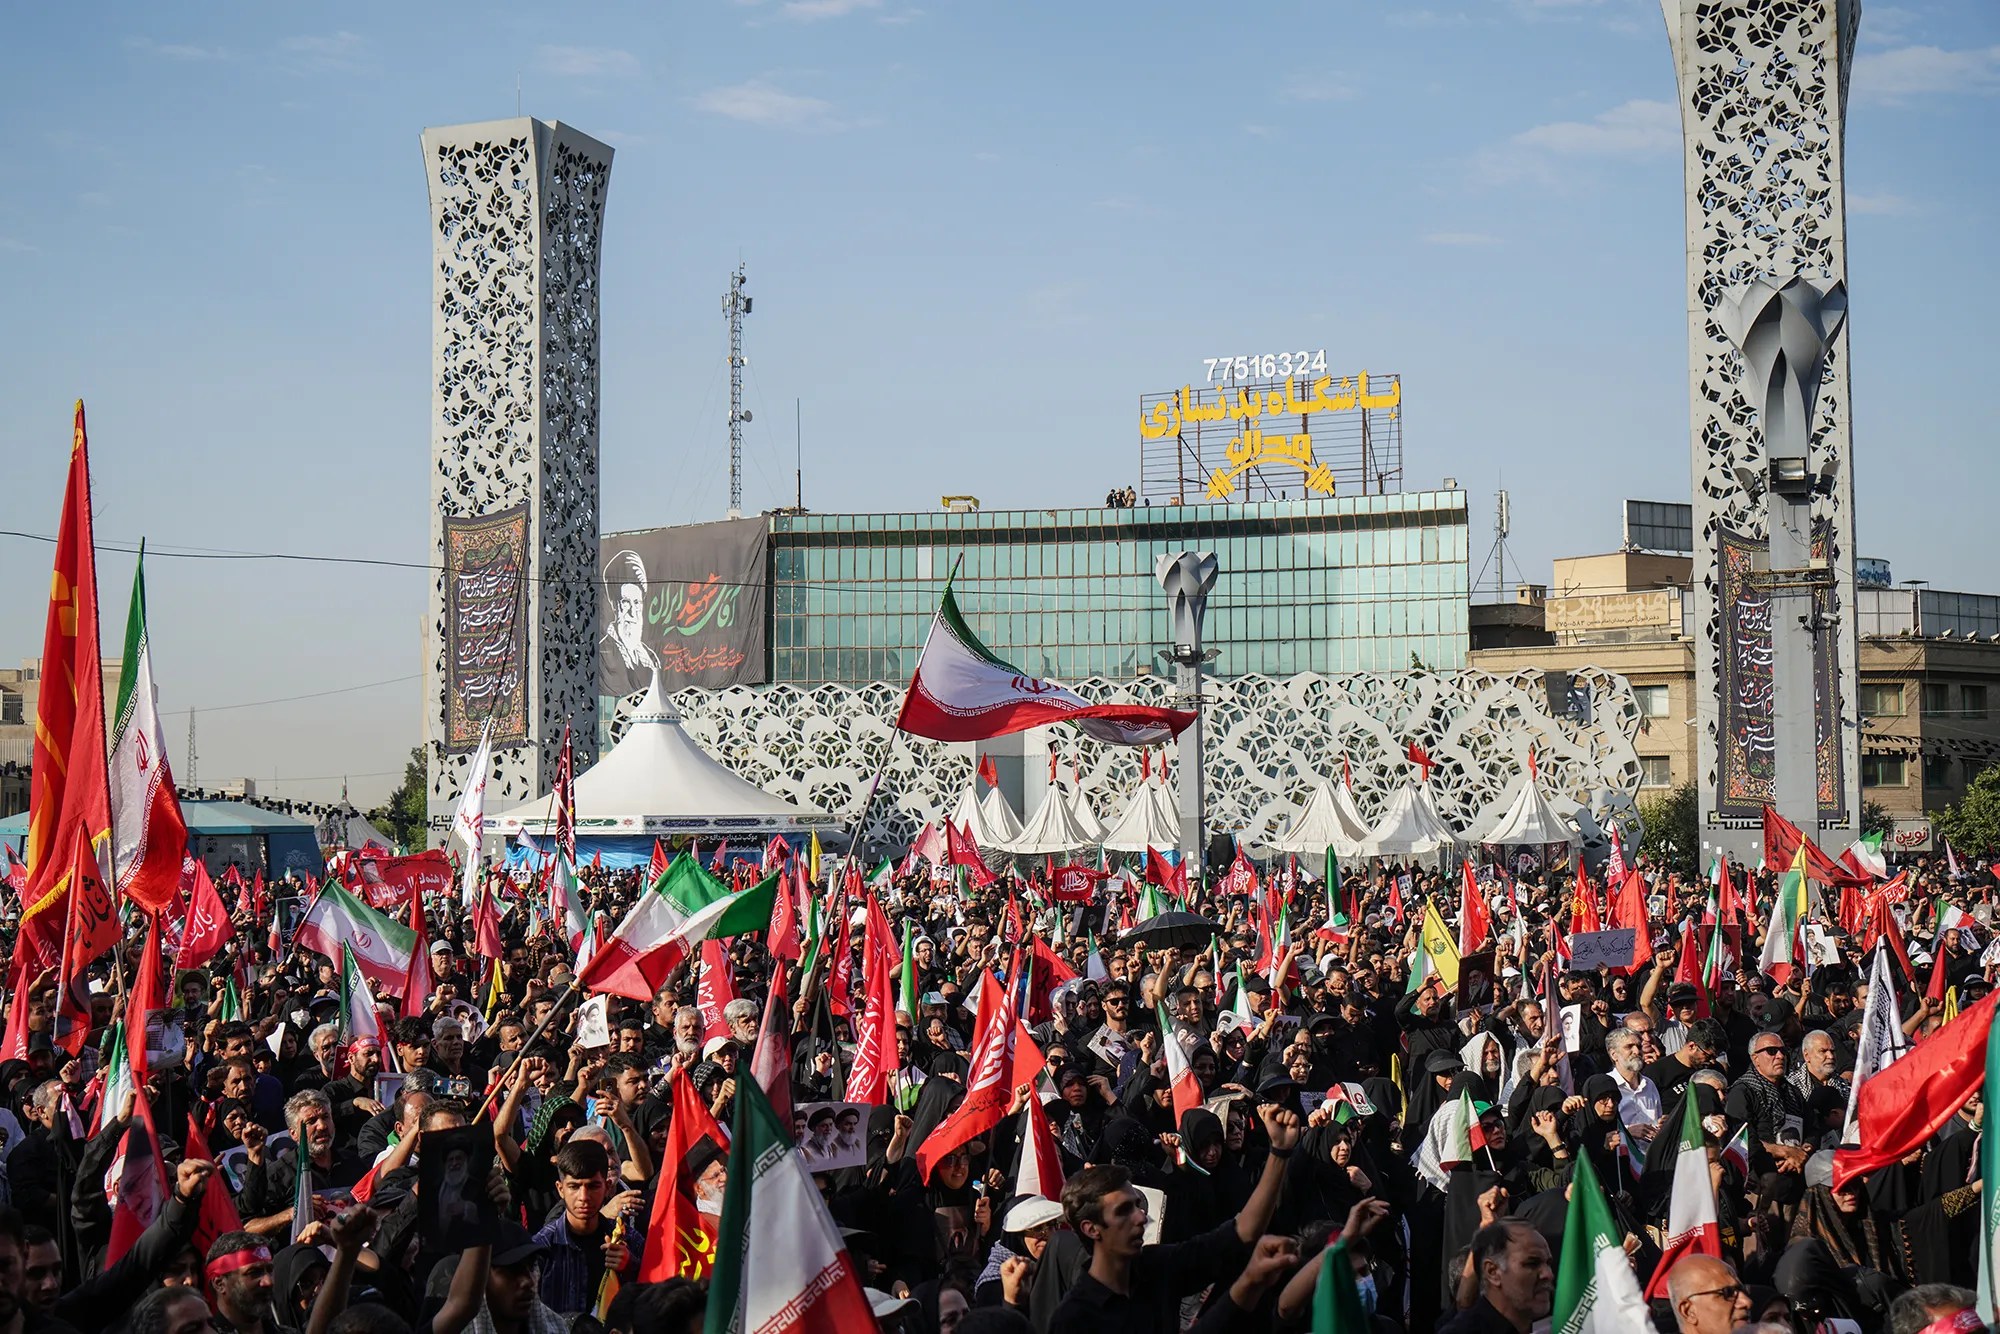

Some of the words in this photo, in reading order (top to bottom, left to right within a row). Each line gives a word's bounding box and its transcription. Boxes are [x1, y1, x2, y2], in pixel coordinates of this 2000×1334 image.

[1203, 349, 1328, 382] 77516324
[1140, 383, 1262, 438] بدنسازی
[1267, 369, 1401, 420] باشگاه
[1894, 826, 1928, 845] نوین
